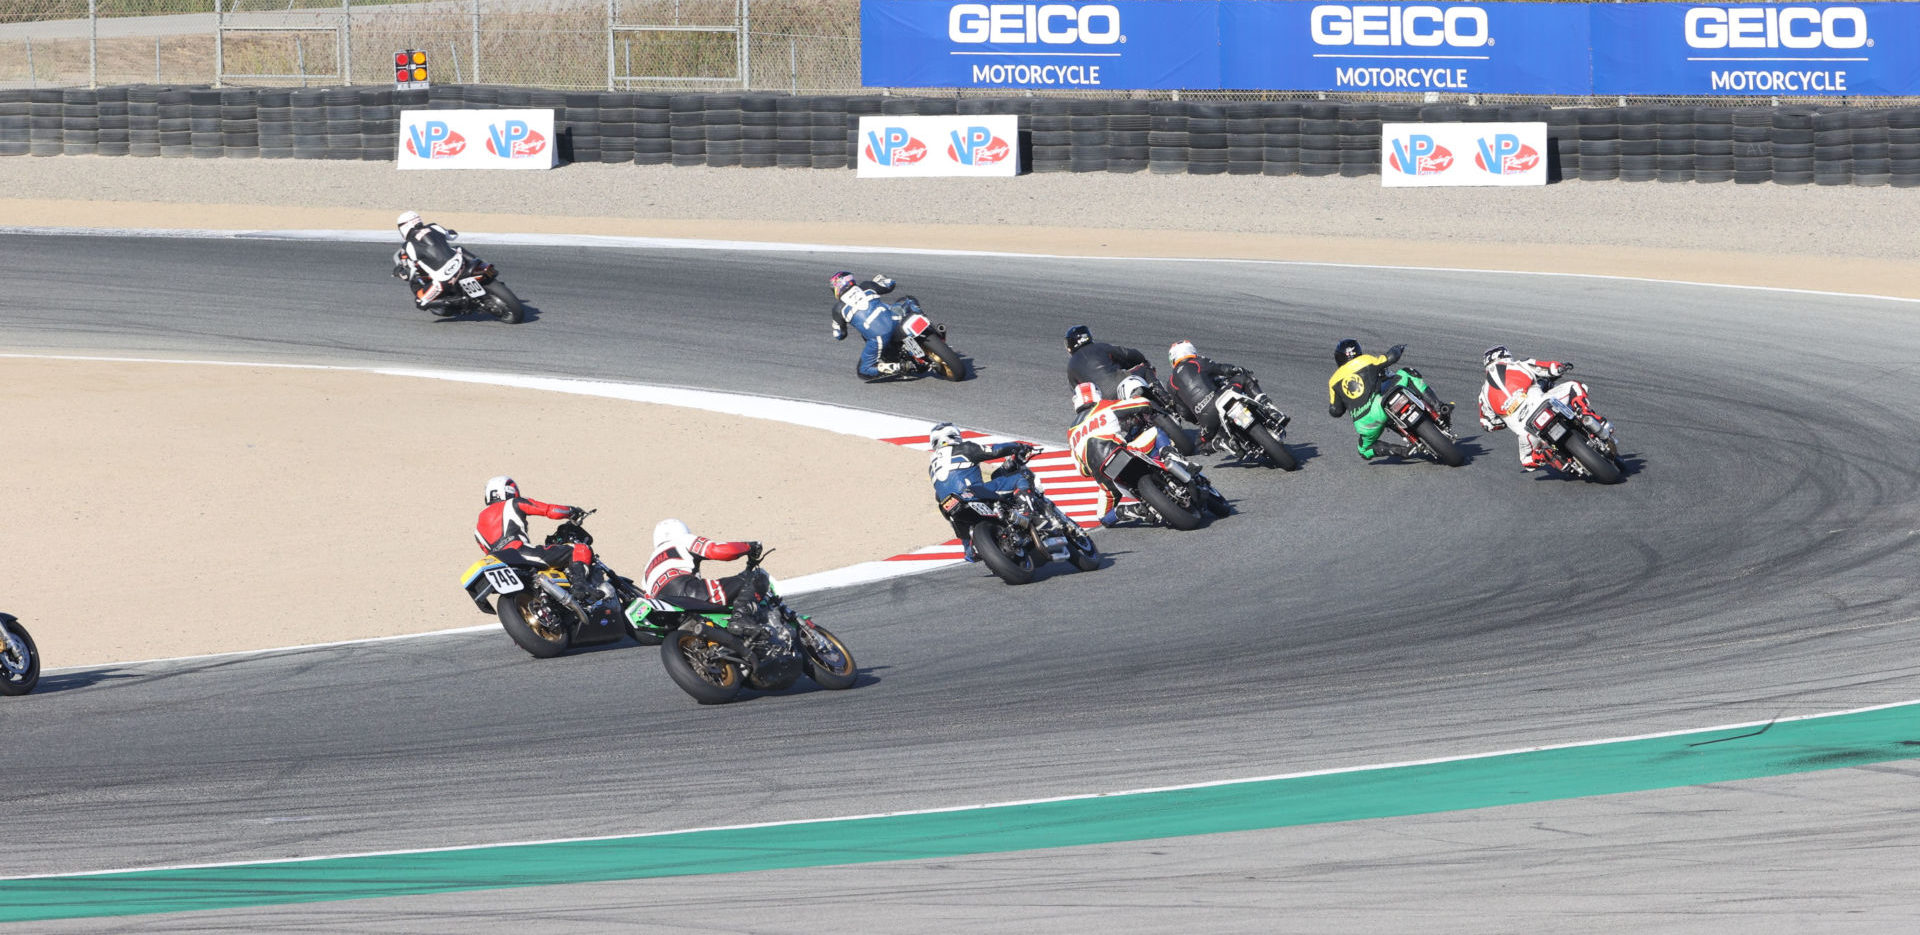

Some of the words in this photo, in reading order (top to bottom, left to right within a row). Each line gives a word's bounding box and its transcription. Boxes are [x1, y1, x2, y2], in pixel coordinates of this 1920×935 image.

[948, 4, 1121, 45] GEICO
[1310, 5, 1489, 47] GEICO
[1684, 7, 1868, 49] GEICO
[972, 64, 1101, 85] MOTORCYCLE
[1336, 67, 1468, 88] MOTORCYCLE
[1711, 70, 1847, 91] MOTORCYCLE
[409, 120, 449, 159] VP
[488, 120, 529, 159] VP
[867, 126, 909, 167] VP
[950, 126, 992, 166] VP
[1391, 134, 1434, 175] VP
[1476, 133, 1520, 175] VP
[1419, 155, 1454, 171] Racing
[1504, 154, 1539, 171] Racing
[1072, 413, 1107, 447] ADAMS
[488, 568, 519, 588] 746
